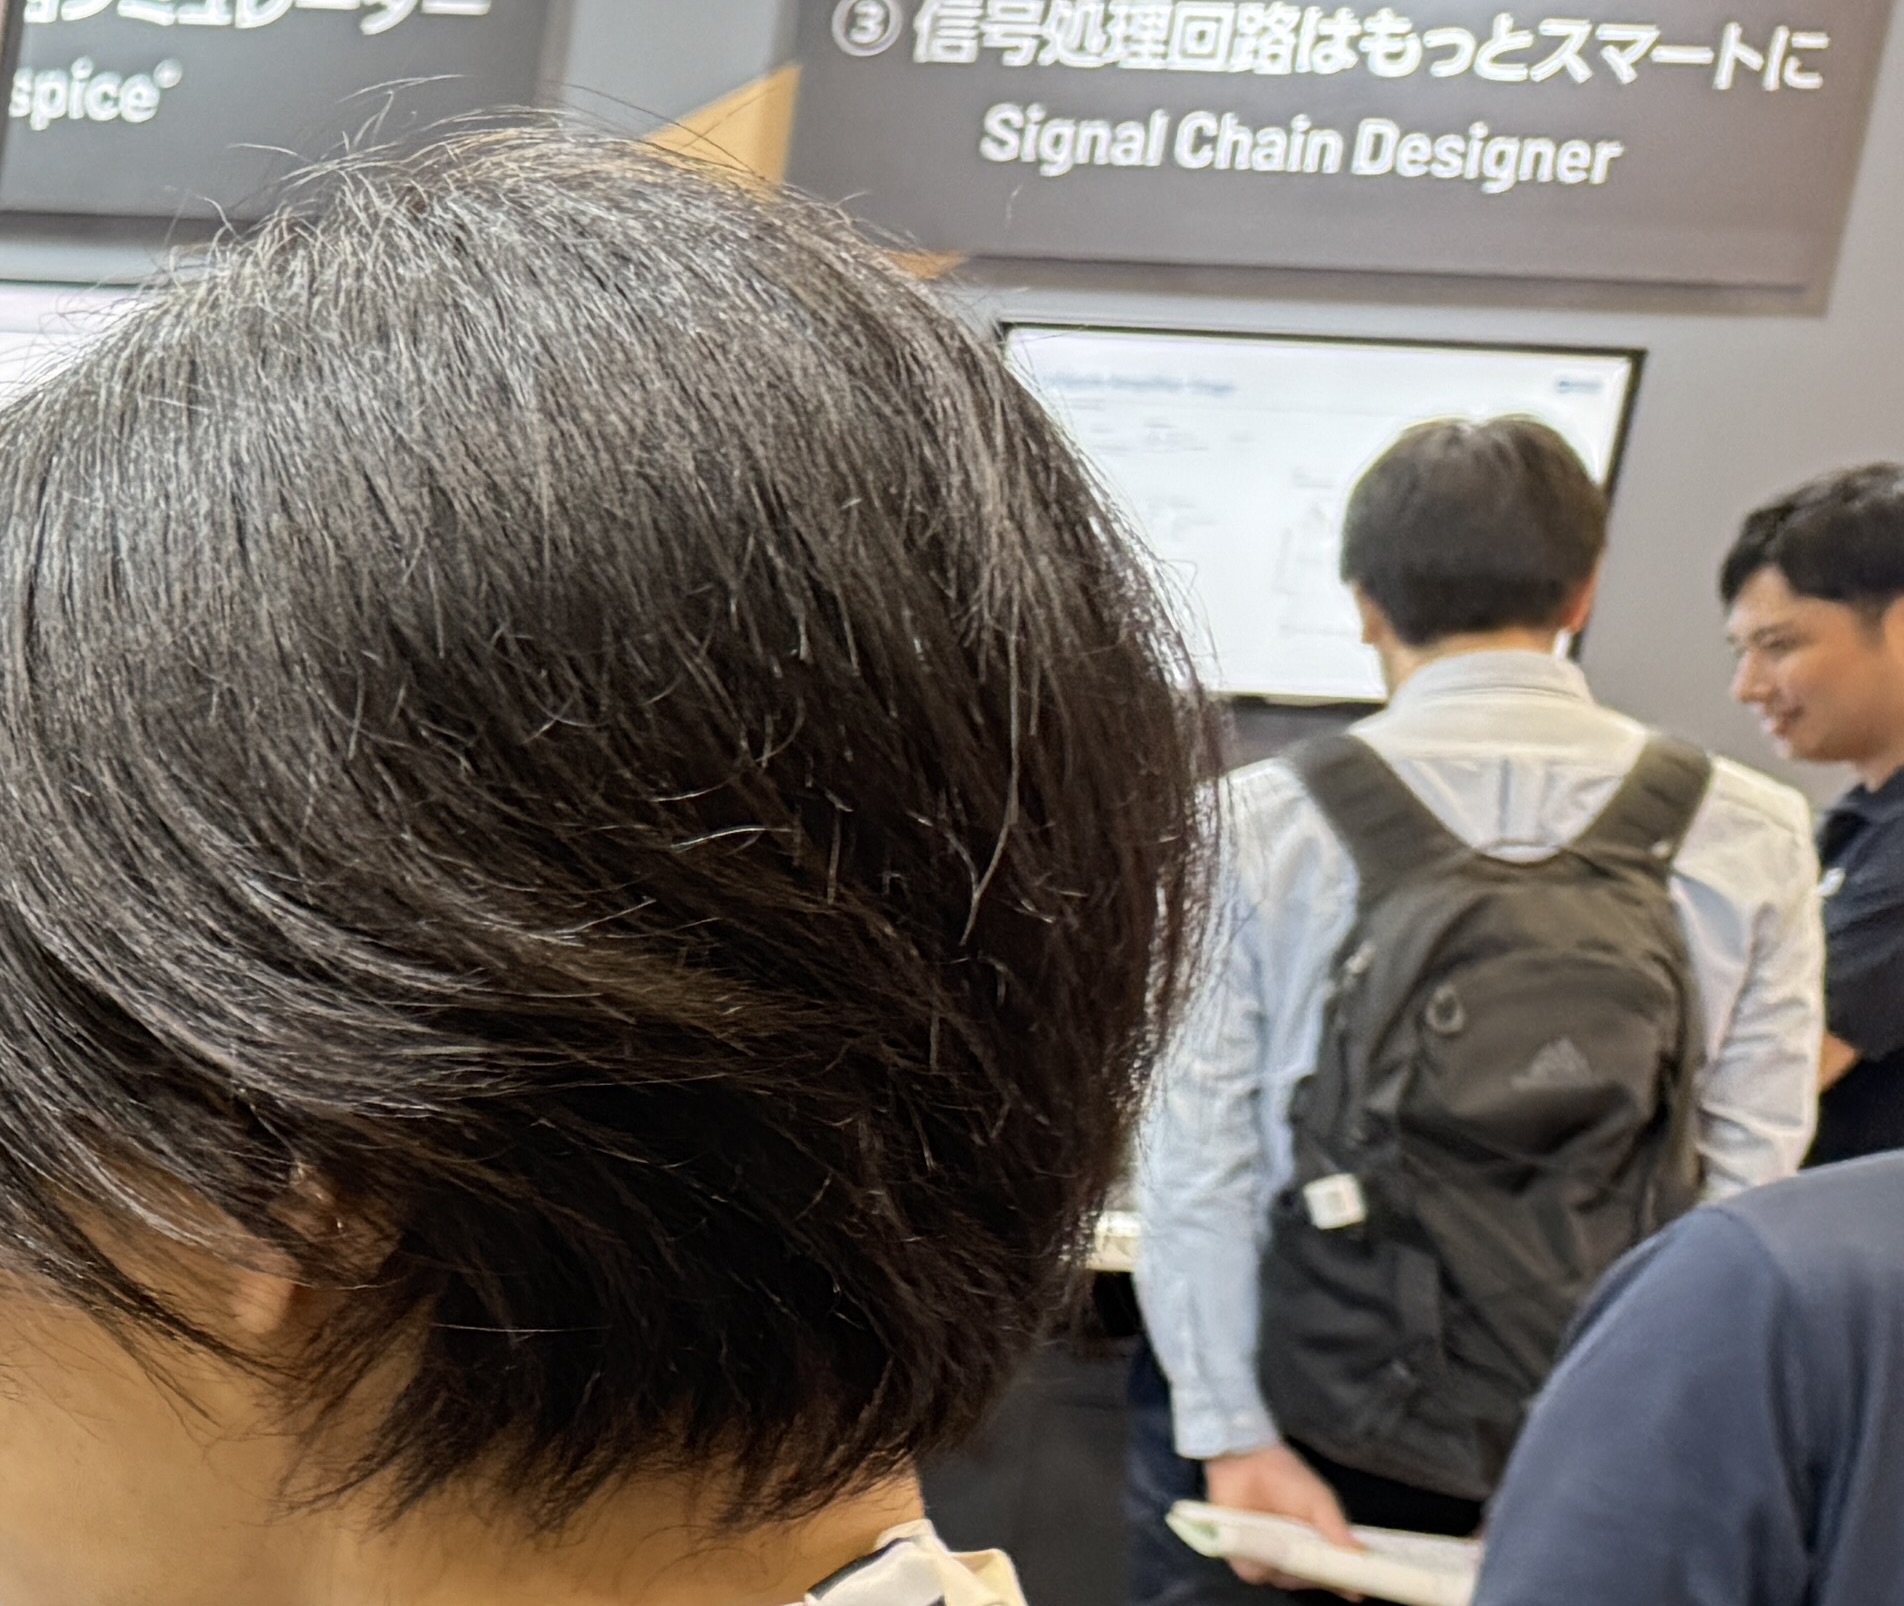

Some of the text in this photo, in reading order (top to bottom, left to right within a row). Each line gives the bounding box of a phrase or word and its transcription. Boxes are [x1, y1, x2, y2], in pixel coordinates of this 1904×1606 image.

[913, 0, 1830, 91] 信号処理回路はもっとスマートに
[981, 102, 1625, 194] Signal Chain Designer
